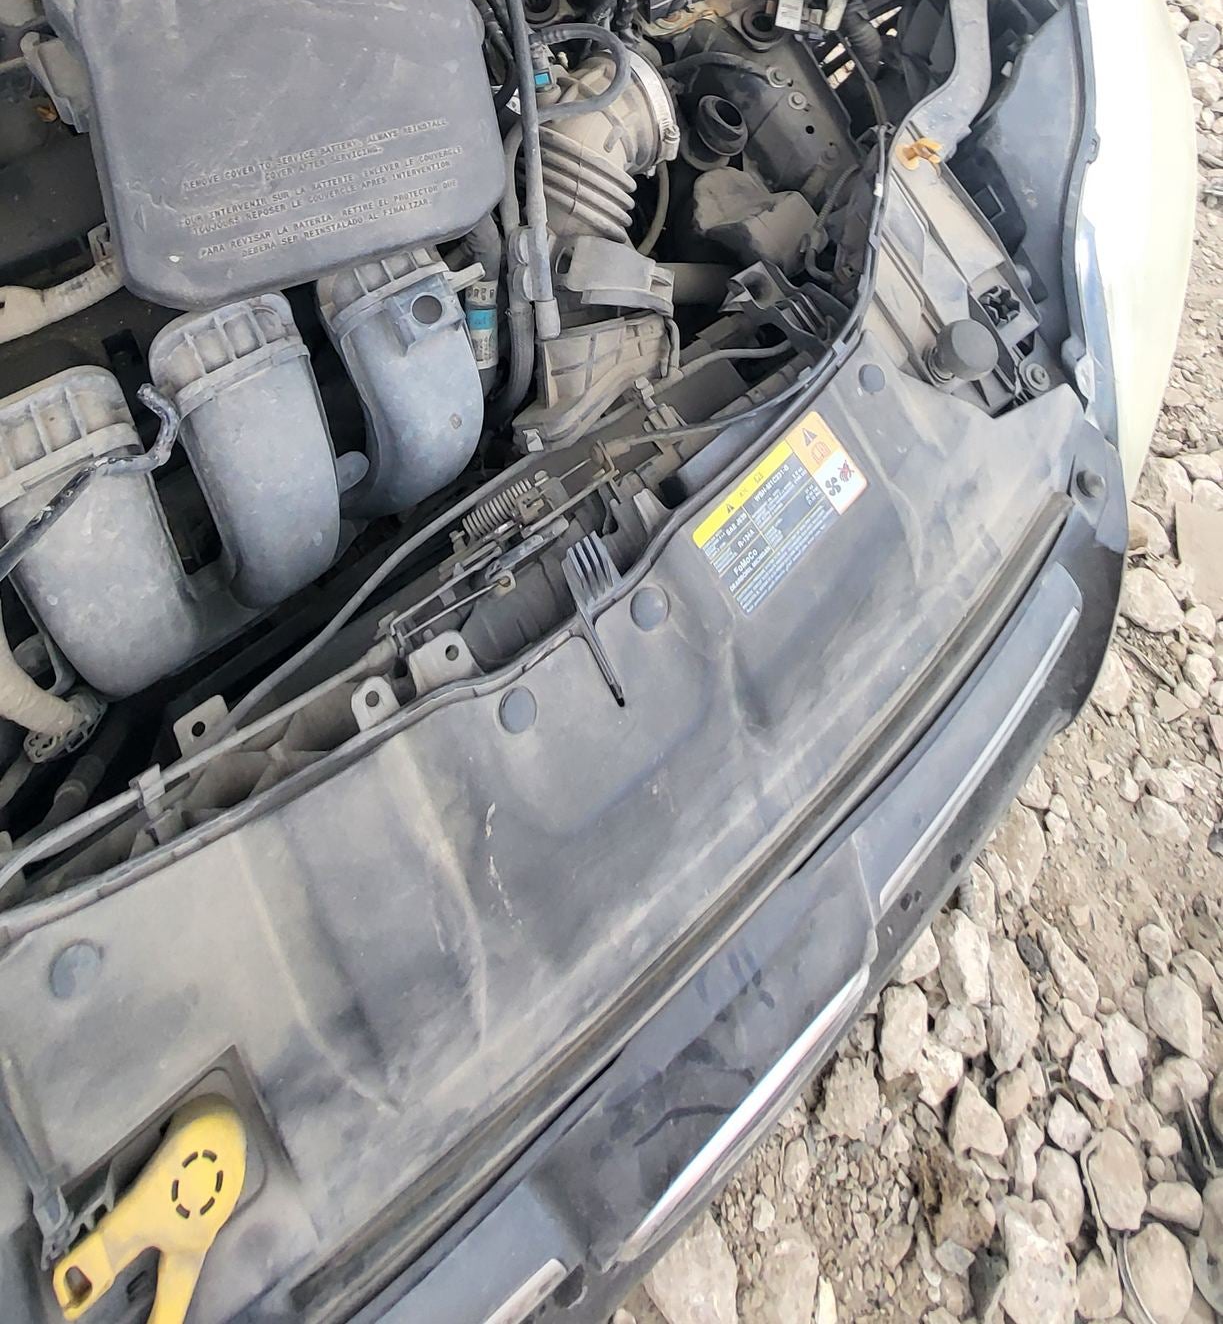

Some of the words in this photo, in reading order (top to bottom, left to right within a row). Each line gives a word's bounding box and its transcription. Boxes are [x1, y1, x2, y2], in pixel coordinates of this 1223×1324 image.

[225, 167, 254, 179] COVER
[259, 162, 271, 171] TO
[277, 150, 315, 166] SERVICE
[264, 168, 293, 181] COVER
[180, 214, 203, 227] OUR
[272, 191, 290, 202] SUR
[231, 231, 272, 248] REVISAR
[277, 227, 288, 235] LA
[732, 548, 758, 576] FoMoCo
